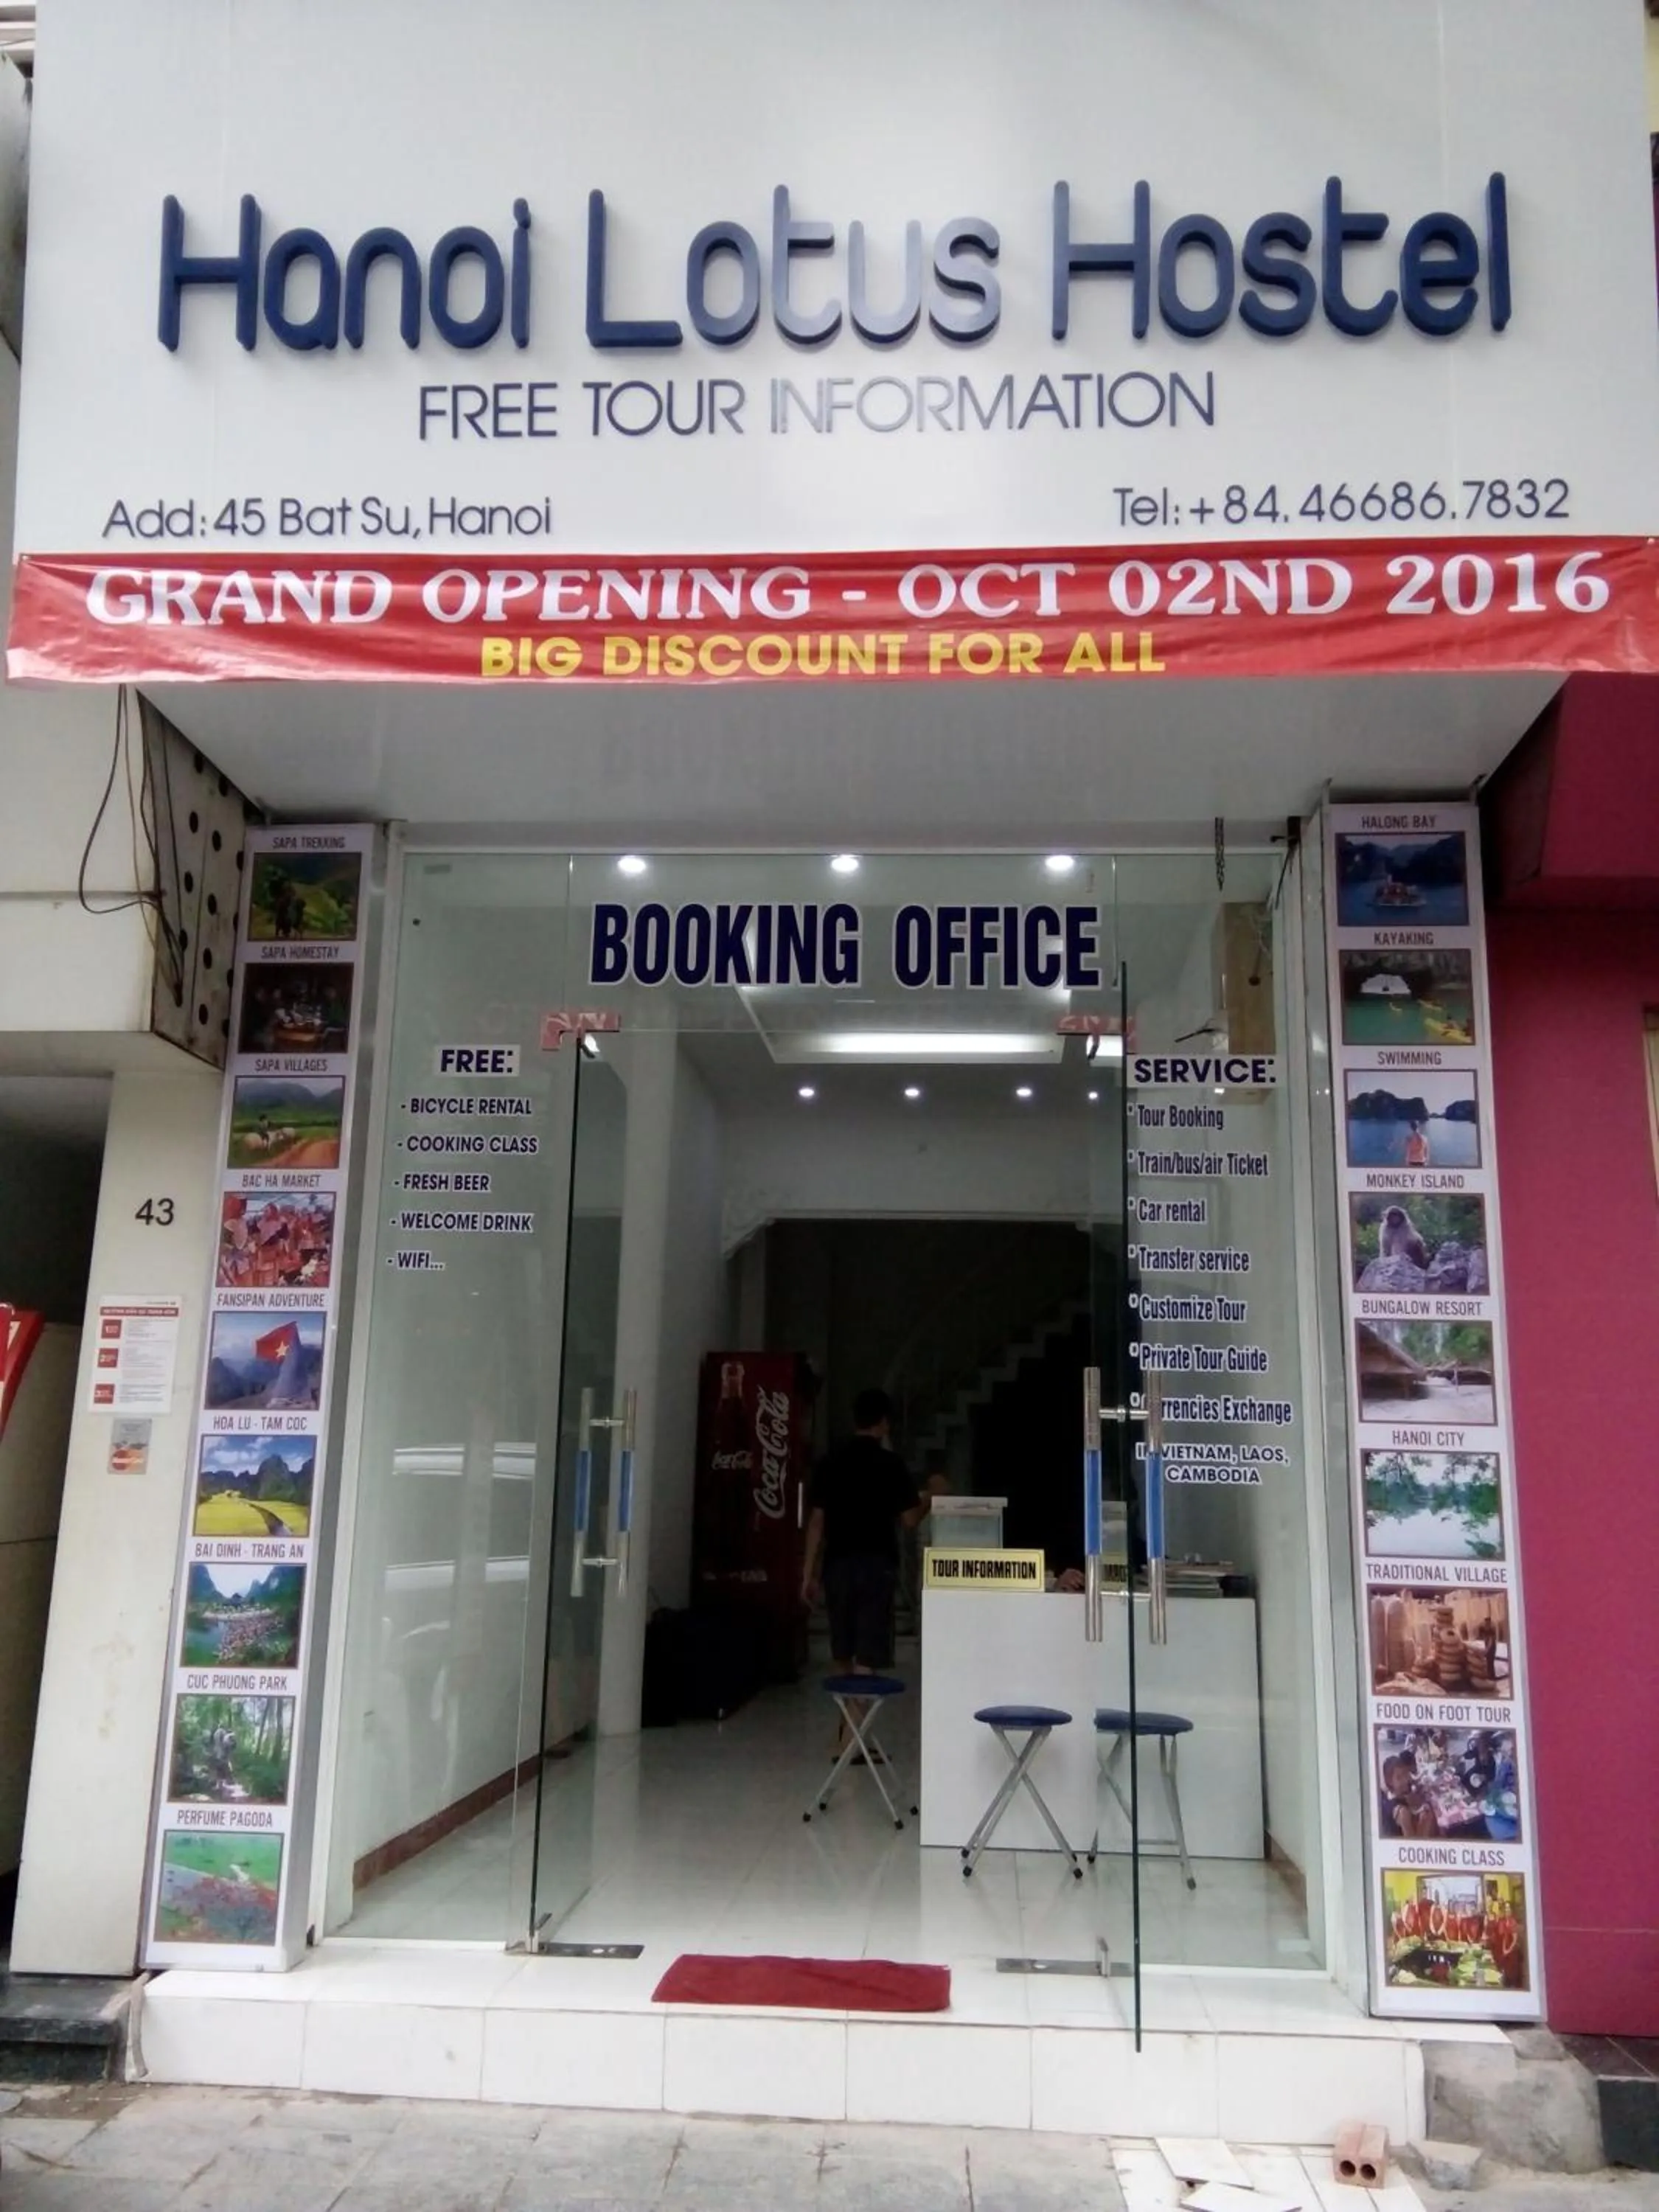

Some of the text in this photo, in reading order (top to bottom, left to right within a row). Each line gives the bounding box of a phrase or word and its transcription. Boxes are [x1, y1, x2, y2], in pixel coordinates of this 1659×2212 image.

[157, 171, 1512, 352] Hanoi Lotus Hostel
[420, 371, 1214, 440] FREE TOUR INFORMATION
[280, 497, 351, 536] Bat
[86, 569, 392, 626] GRAND
[421, 566, 813, 623] OPENING
[898, 563, 1075, 619] OCT
[1108, 557, 1353, 616] 02ND
[1386, 552, 1610, 614] 2016
[481, 631, 1165, 677] BIG DISCOUNT FOR ALL
[1362, 815, 1436, 827] HALONG BAY
[273, 837, 345, 848] SAPA TREKKING
[591, 902, 1099, 989] BOOKING OFFICE
[1374, 932, 1433, 945] KAYAKING
[261, 946, 339, 959] SAPA HOMESTAY
[255, 1059, 328, 1071] SAPA VILLAGES
[440, 1049, 512, 1073] FREE:
[1377, 1051, 1441, 1065] SWIMMING
[1135, 1059, 1276, 1082] SERVICE:
[411, 1098, 532, 1115] BICYCLE RENTAL
[1138, 1105, 1224, 1130] Tour Booking
[406, 1136, 538, 1153] COOKING CLASS
[1138, 1152, 1269, 1175] Train/bus/air Ticket
[242, 1175, 321, 1187] BAC HA MARKET
[403, 1174, 490, 1191] FRESH BEER
[1366, 1174, 1464, 1189] MONKEY ISLAND
[135, 1198, 175, 1226] 43
[1138, 1199, 1205, 1222] Car rental
[401, 1213, 532, 1231] WELCOME DRINK
[1139, 1247, 1249, 1271] Transfer service
[217, 1293, 325, 1307] FANSIPAN ADVENTURE
[1142, 1295, 1245, 1321] Customize Tour
[1362, 1300, 1481, 1315] BUNGALOW RESORT
[1143, 1343, 1267, 1371] Private Tour Guide
[1143, 1395, 1291, 1425] rrencies Exchange
[214, 1416, 234, 1430] HOA
[238, 1416, 251, 1430] LU
[261, 1416, 282, 1430] TAM
[286, 1416, 307, 1430] COC
[1393, 1430, 1464, 1447] HANOI CITY
[1242, 1448, 1288, 1464] LAOS,
[1167, 1467, 1260, 1483] CAMBODIA
[195, 1543, 212, 1557] BAI
[216, 1543, 241, 1557] DINH
[252, 1543, 285, 1558] TRANG
[288, 1544, 305, 1558] AN
[932, 1559, 1037, 1579] TOUR INFORMATION
[1366, 1563, 1506, 1583] TRADITIONAL VILLAGE
[187, 1674, 287, 1691] CUC PHUONG PARK
[1377, 1703, 1511, 1722] FOOD ON FOOT TOUR
[177, 1809, 273, 1827] PERFUME PAGODA
[1399, 1847, 1505, 1866] COOKING CLASS
